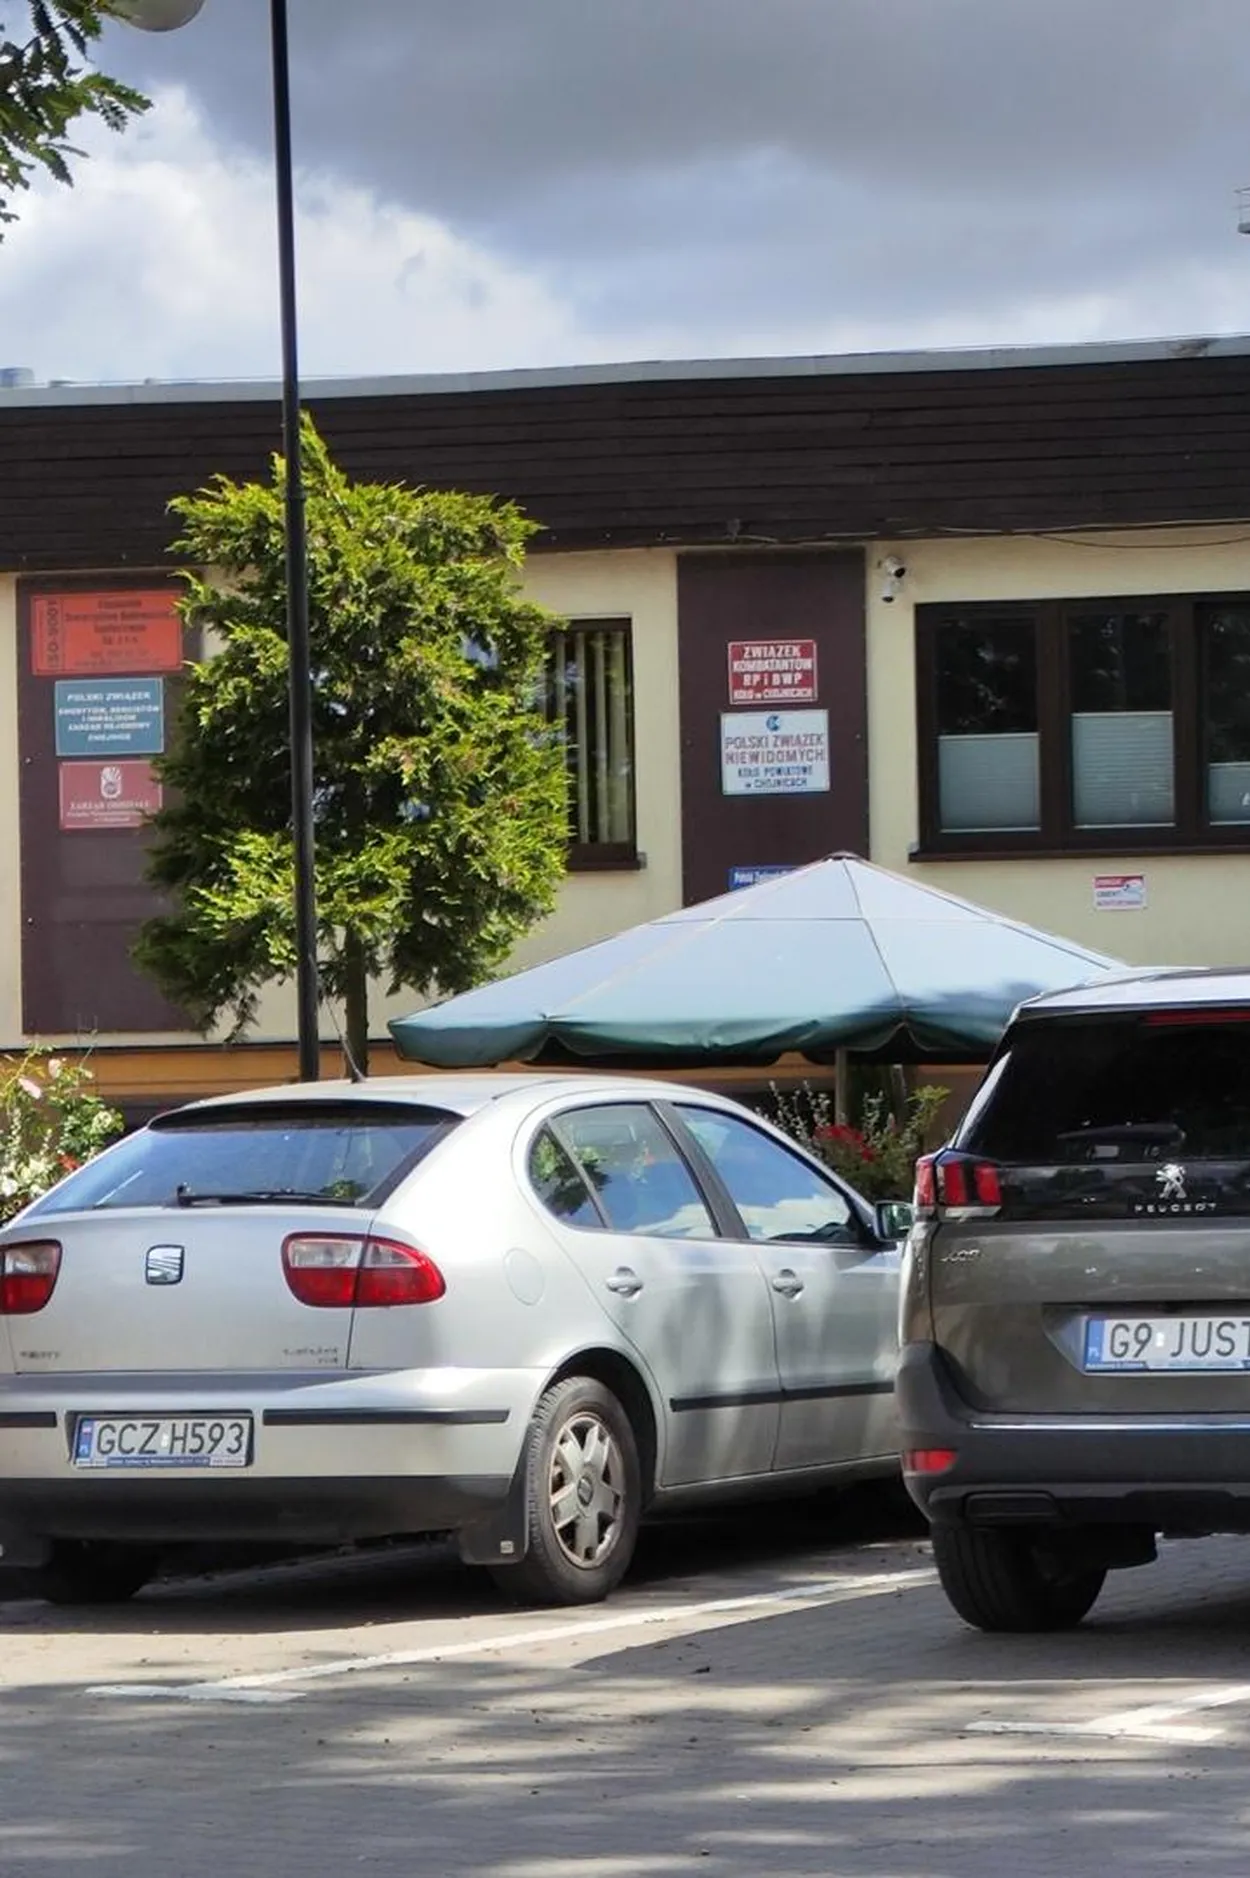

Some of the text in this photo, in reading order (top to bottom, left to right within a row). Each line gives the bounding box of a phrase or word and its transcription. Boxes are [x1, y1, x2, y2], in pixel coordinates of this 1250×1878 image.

[725, 749, 824, 764] NIEWIDOMYCH
[1134, 1202, 1216, 1213] PEUGEOT
[1110, 1322, 1153, 1358] G9
[97, 1422, 244, 1455] GCZ H593
